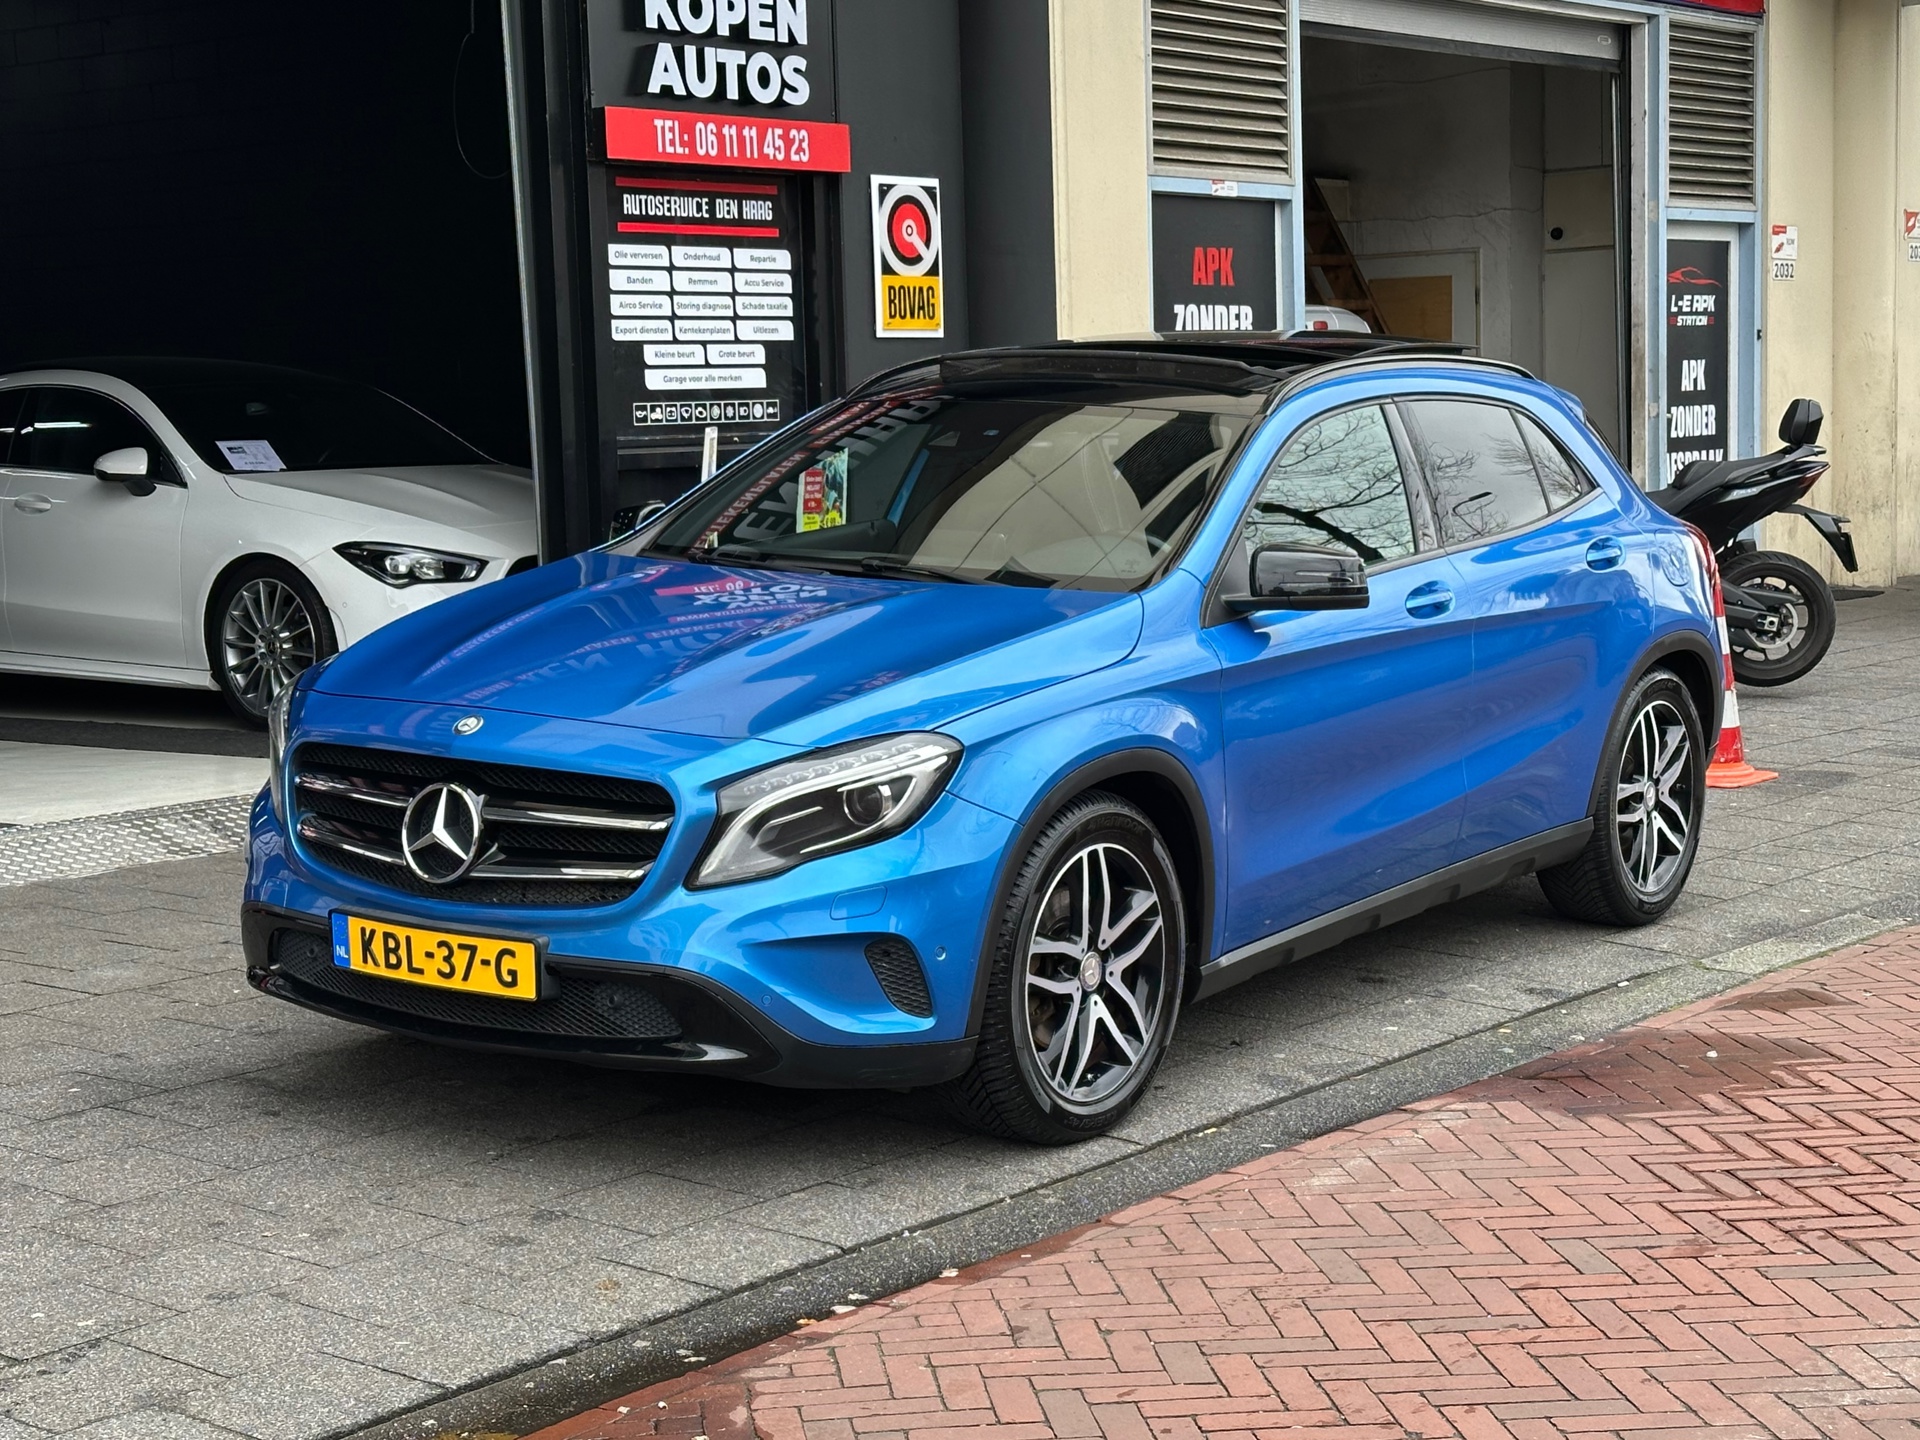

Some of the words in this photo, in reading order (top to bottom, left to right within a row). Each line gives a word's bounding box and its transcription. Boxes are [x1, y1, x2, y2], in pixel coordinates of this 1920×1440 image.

[644, 0, 808, 45] KOPEN
[647, 42, 811, 106] AUTOS
[653, 118, 690, 155] TEL:
[695, 121, 718, 158] 06
[722, 123, 739, 158] 11
[743, 125, 759, 160] 11
[763, 127, 785, 162] 45
[789, 129, 810, 163] 23
[622, 194, 710, 218] AUTOSERVICE
[715, 198, 739, 220] DEN
[742, 200, 773, 221] HAAG
[614, 250, 629, 260] Olie
[630, 252, 663, 261] verversen
[683, 252, 721, 262] Onderhoud
[749, 255, 777, 265] Repartie
[1192, 247, 1235, 287] APK
[1774, 262, 1795, 279] 2032
[626, 276, 654, 285] Banden
[688, 277, 718, 286] Remmen
[744, 279, 760, 287] Accu
[761, 279, 785, 288] Service
[618, 301, 637, 310] Airco
[638, 301, 663, 310] Service
[676, 301, 700, 312] Storing
[701, 301, 732, 312] diagnose
[741, 302, 765, 311] Schade
[766, 302, 788, 311] taxatie
[887, 285, 936, 321] BOVAG
[1670, 294, 1691, 313] L-E
[1692, 294, 1716, 313] APK
[1173, 304, 1253, 331] ZONDER
[1676, 315, 1708, 326] STATION
[615, 326, 638, 336] Export
[639, 326, 669, 335] diensten
[679, 326, 731, 336] Kentekenplaten
[753, 326, 779, 335] Uitlezen
[654, 350, 676, 359] Kleine
[676, 350, 696, 359] beurt
[718, 350, 737, 359] Grote
[737, 350, 756, 358] beurt
[663, 375, 687, 384] Garage
[704, 374, 716, 383] alle
[717, 374, 743, 383] merken
[1681, 359, 1706, 392] APK
[1670, 404, 1716, 439] ZONDER
[336, 944, 349, 959] NL
[360, 926, 519, 989] KBL-37-G
